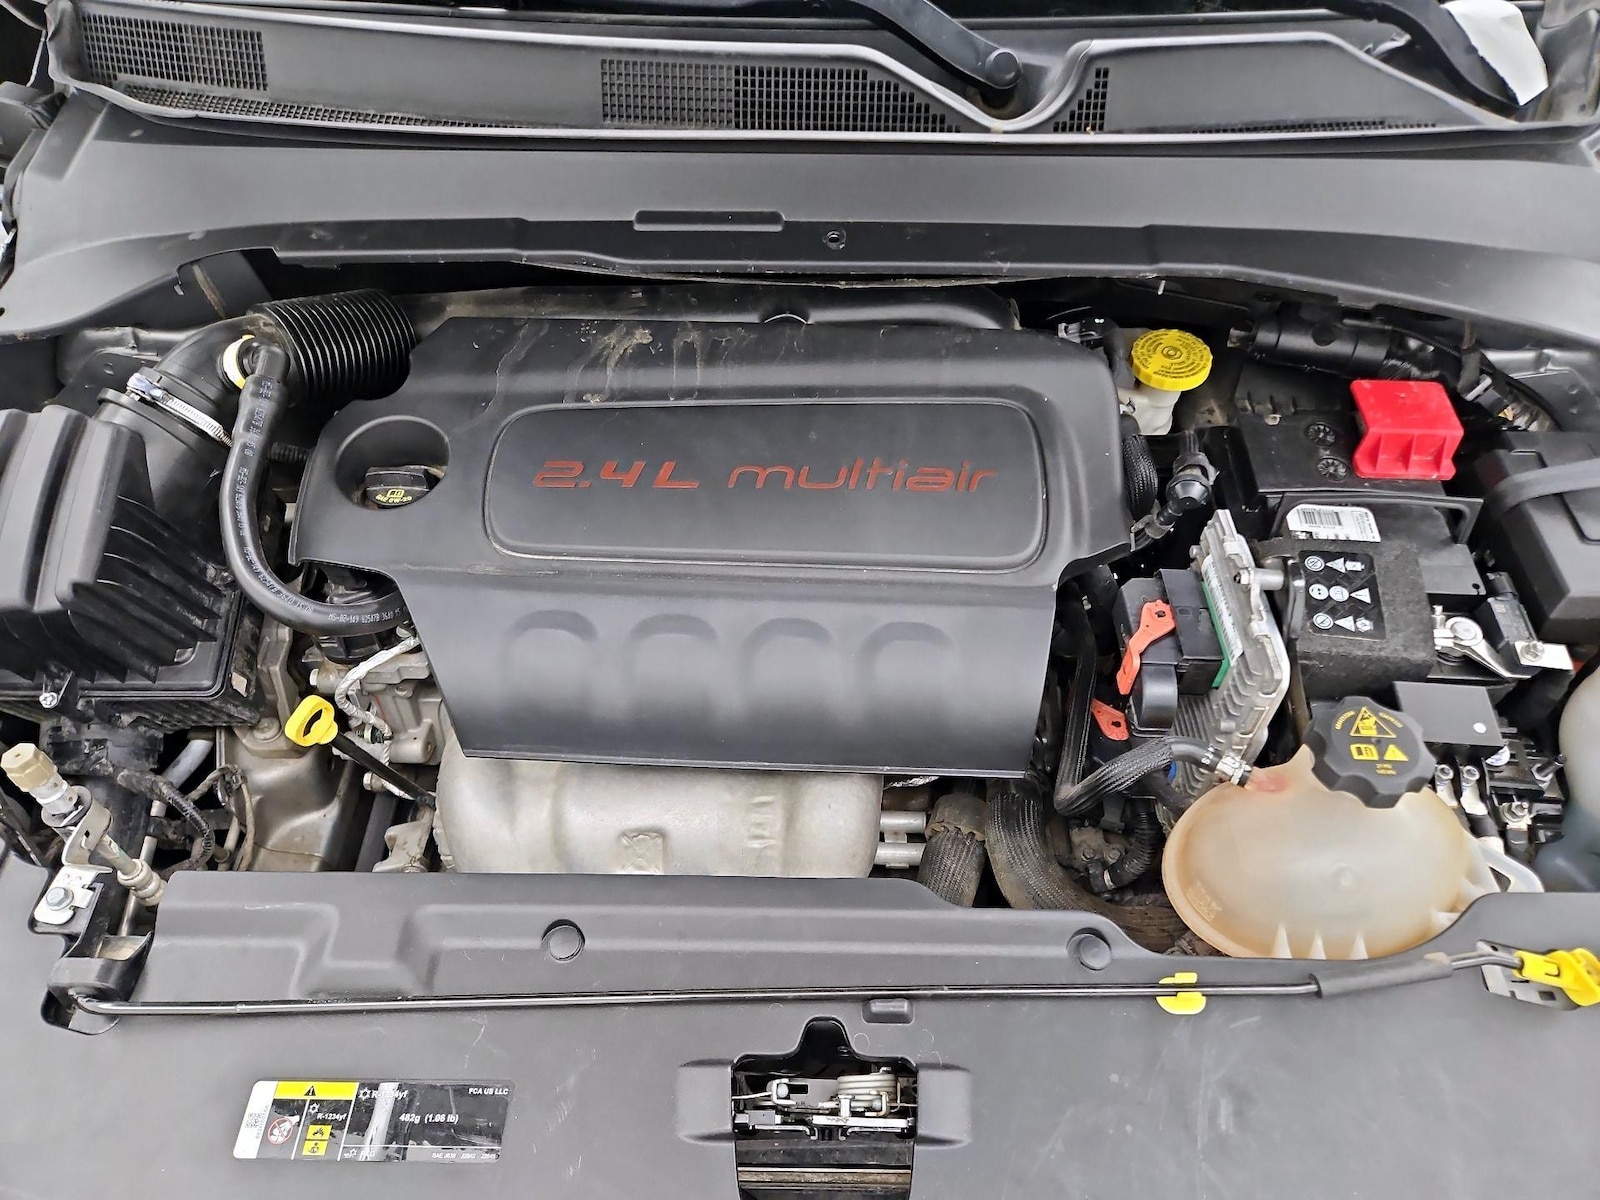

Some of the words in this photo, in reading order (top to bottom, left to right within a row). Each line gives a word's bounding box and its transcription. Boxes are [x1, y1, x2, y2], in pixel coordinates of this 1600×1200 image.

[727, 457, 998, 492] multiair
[469, 1087, 483, 1095] FCA
[484, 1087, 494, 1095] US
[495, 1087, 509, 1095] LLC
[317, 1112, 347, 1122] R-1234yf
[399, 1113, 420, 1124] 482g
